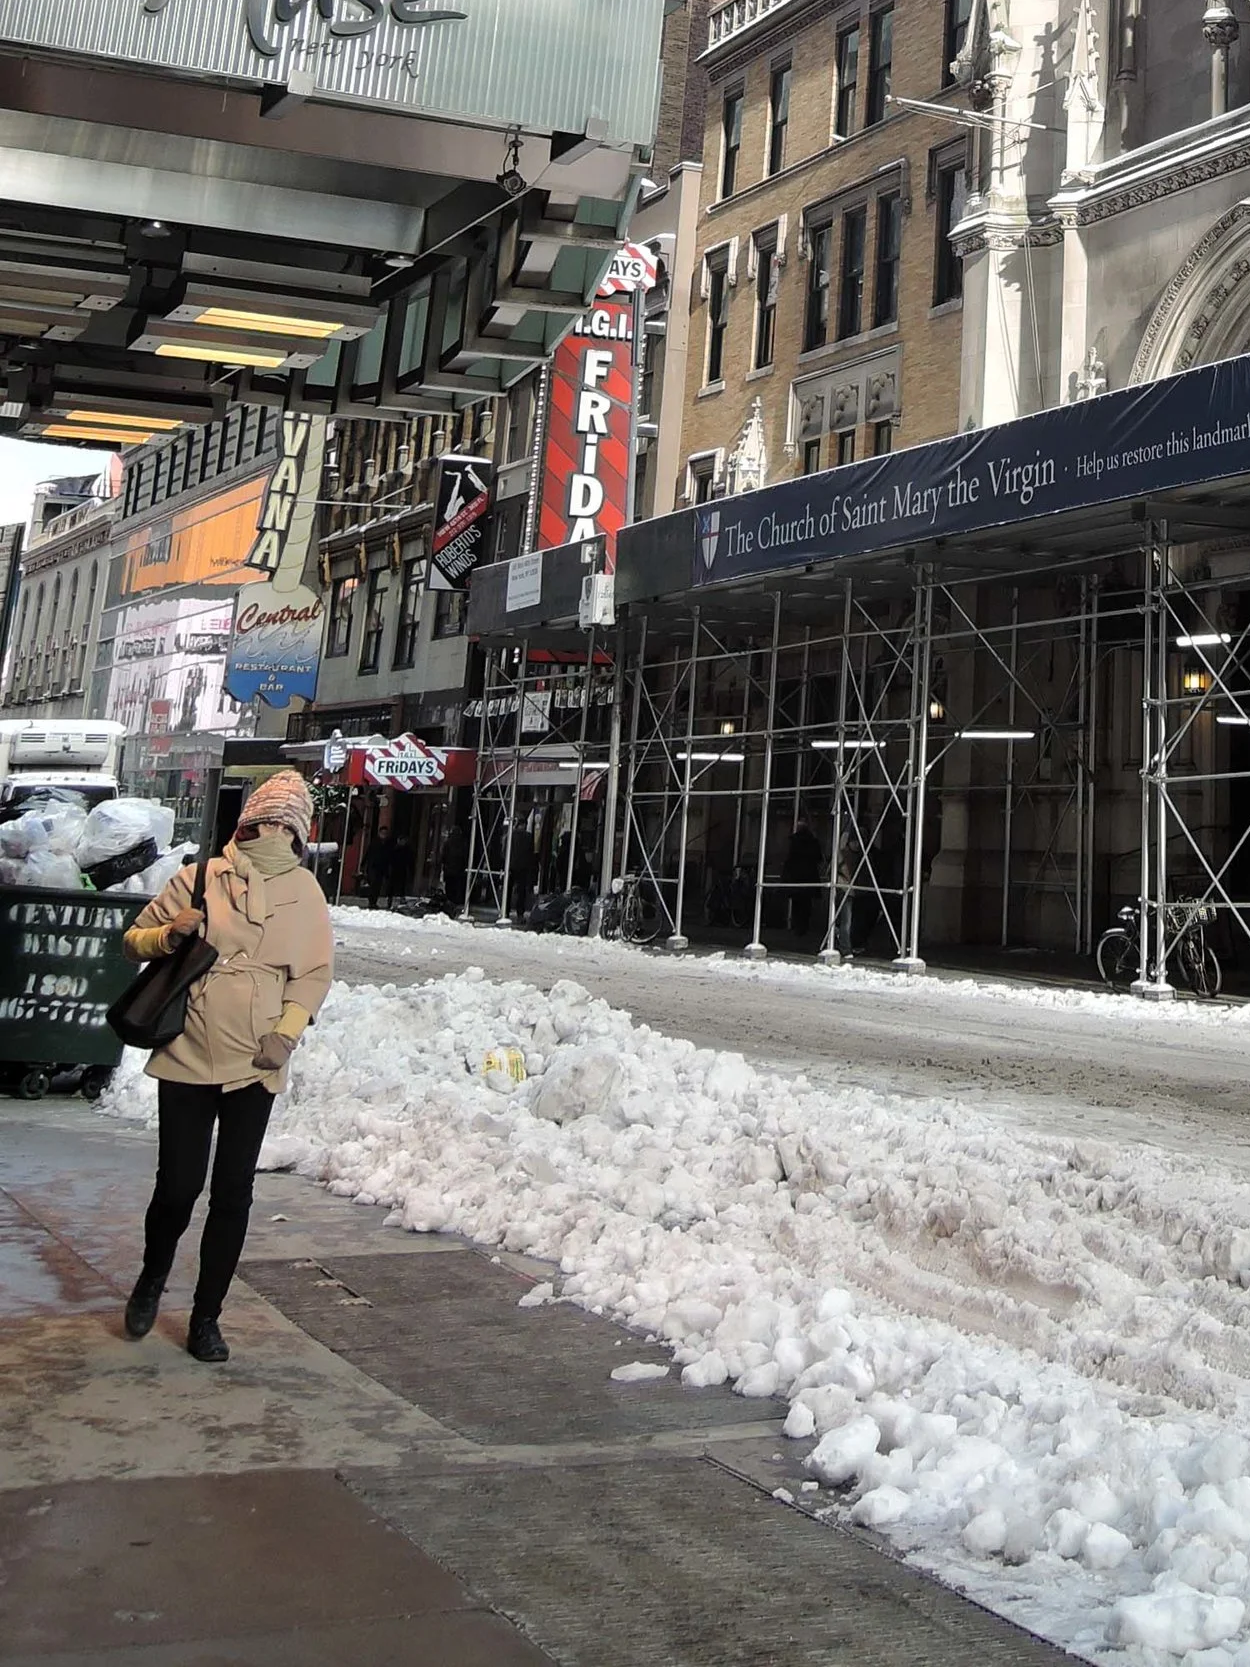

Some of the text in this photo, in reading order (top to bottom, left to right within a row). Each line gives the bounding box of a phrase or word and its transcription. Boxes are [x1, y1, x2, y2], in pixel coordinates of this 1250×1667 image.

[289, 37, 420, 79] new york
[251, 412, 312, 568] VANA
[724, 525, 753, 557] The
[758, 503, 814, 548] Church
[819, 495, 842, 537] of
[841, 492, 886, 531] Saint
[892, 481, 942, 525] Mary
[947, 466, 980, 508] the
[987, 450, 1056, 506] Virgin
[1076, 455, 1104, 481] Help
[1106, 454, 1119, 471] us
[1122, 441, 1164, 466] restore
[1166, 432, 1190, 456] this
[435, 525, 482, 568] ROBERTO'S
[445, 548, 477, 579] WINDS
[236, 598, 322, 634] Central
[235, 663, 312, 673] RESTAURANT
[260, 683, 284, 691] BAR
[9, 903, 130, 929] CENTURY
[23, 934, 107, 958] WASTE
